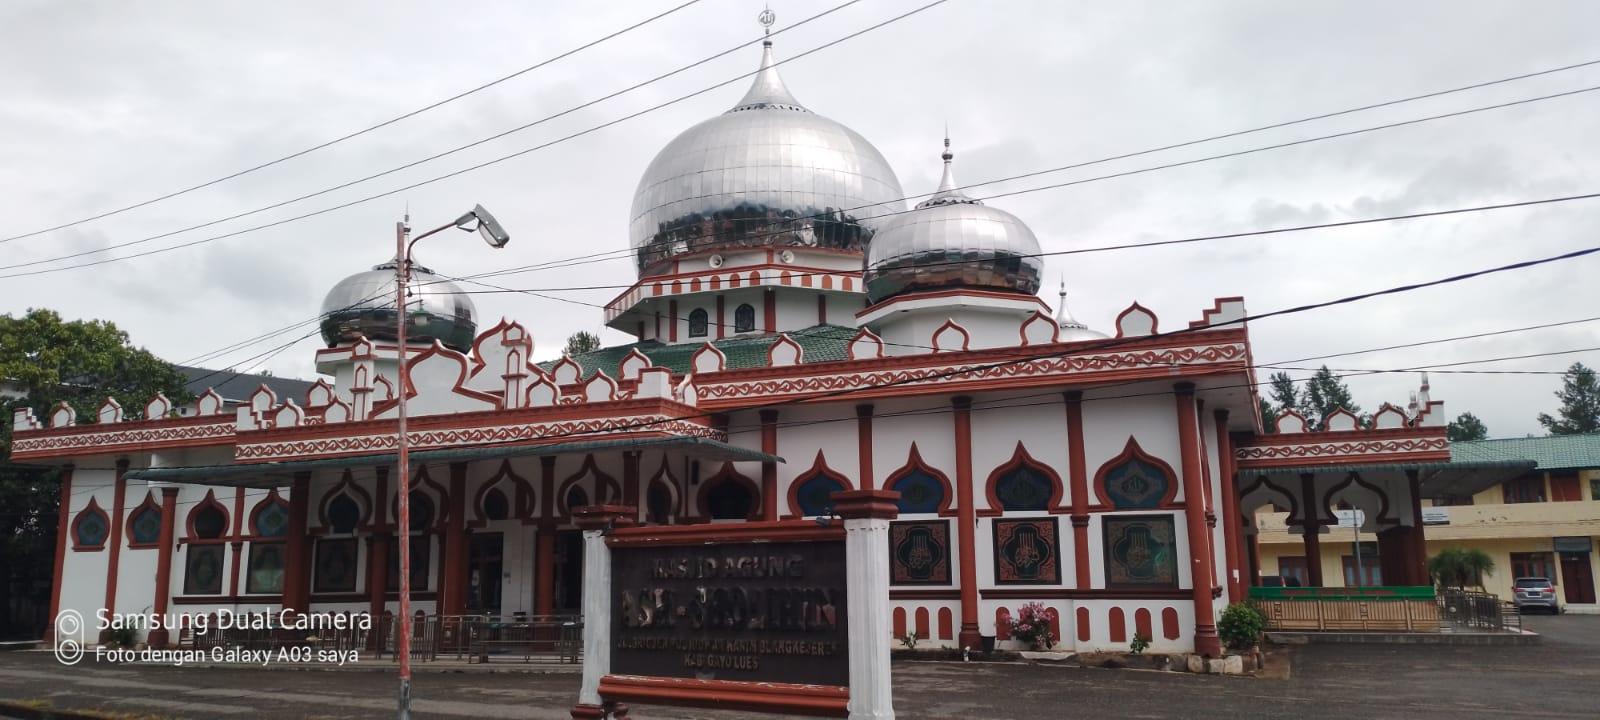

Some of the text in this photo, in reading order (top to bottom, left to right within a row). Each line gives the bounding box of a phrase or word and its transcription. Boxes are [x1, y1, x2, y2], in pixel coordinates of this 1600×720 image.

[722, 554, 804, 578] AGUNG
[707, 654, 732, 669] GAYO
[734, 655, 760, 670] LUES
